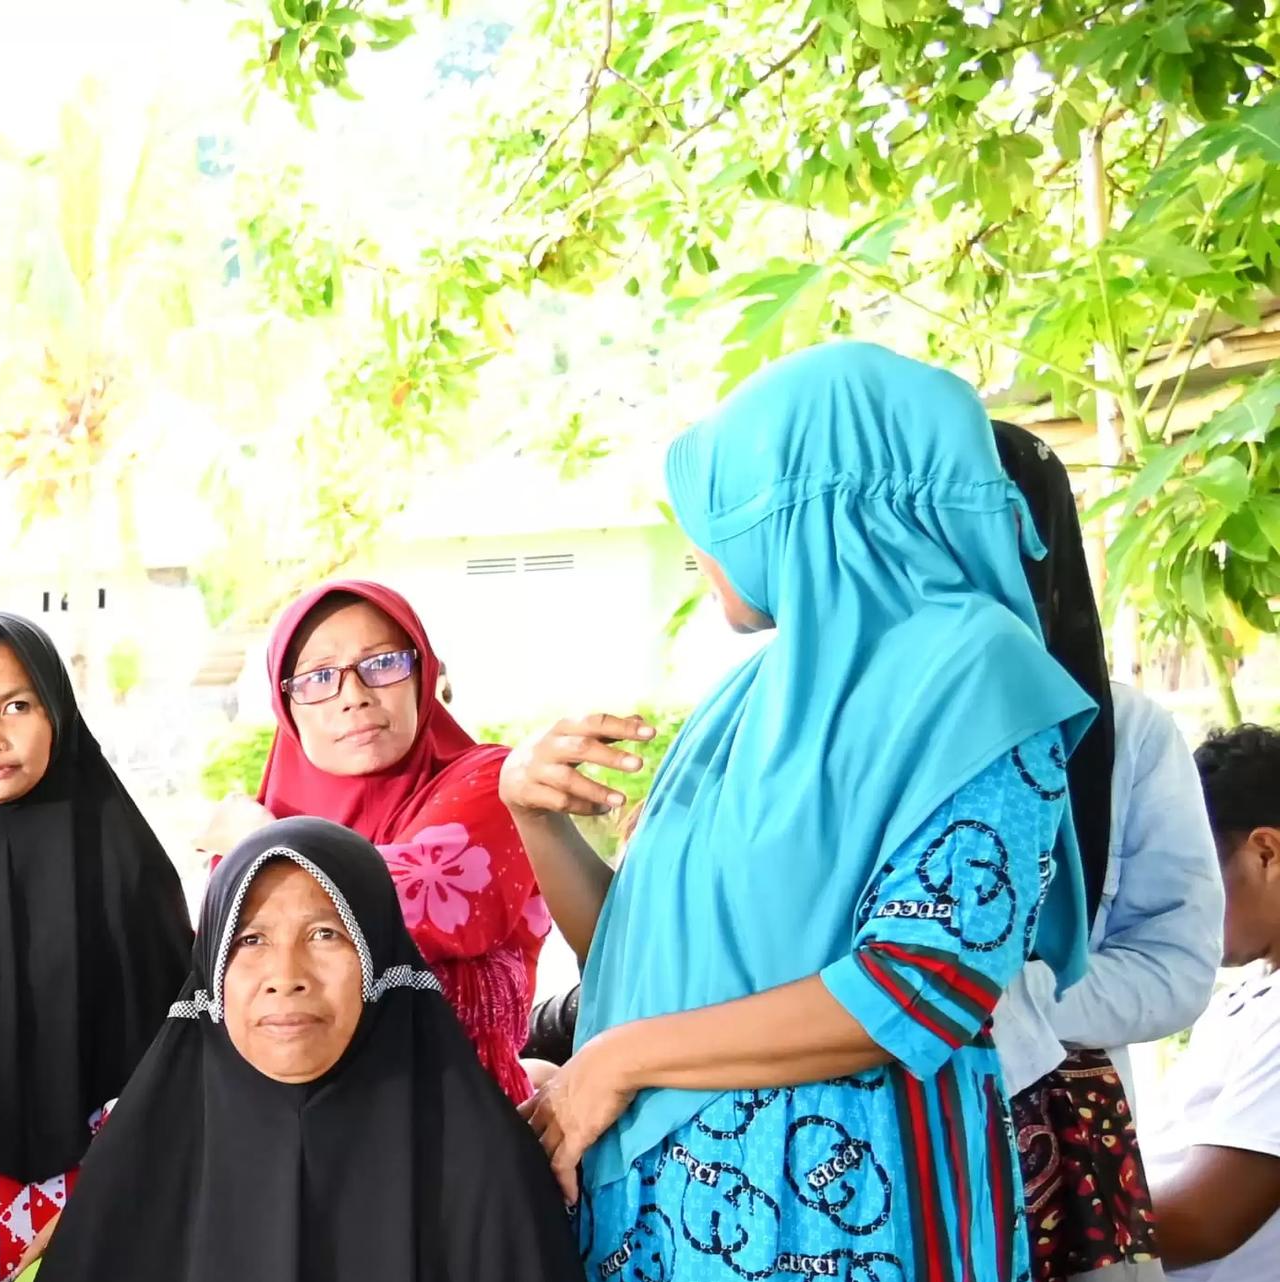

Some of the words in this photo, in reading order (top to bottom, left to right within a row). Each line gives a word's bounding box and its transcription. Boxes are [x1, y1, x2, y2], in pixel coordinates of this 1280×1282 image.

[672, 1145, 717, 1185] GCCI
[807, 1145, 858, 1188] GUCCI
[777, 1254, 837, 1275] GUCCI
